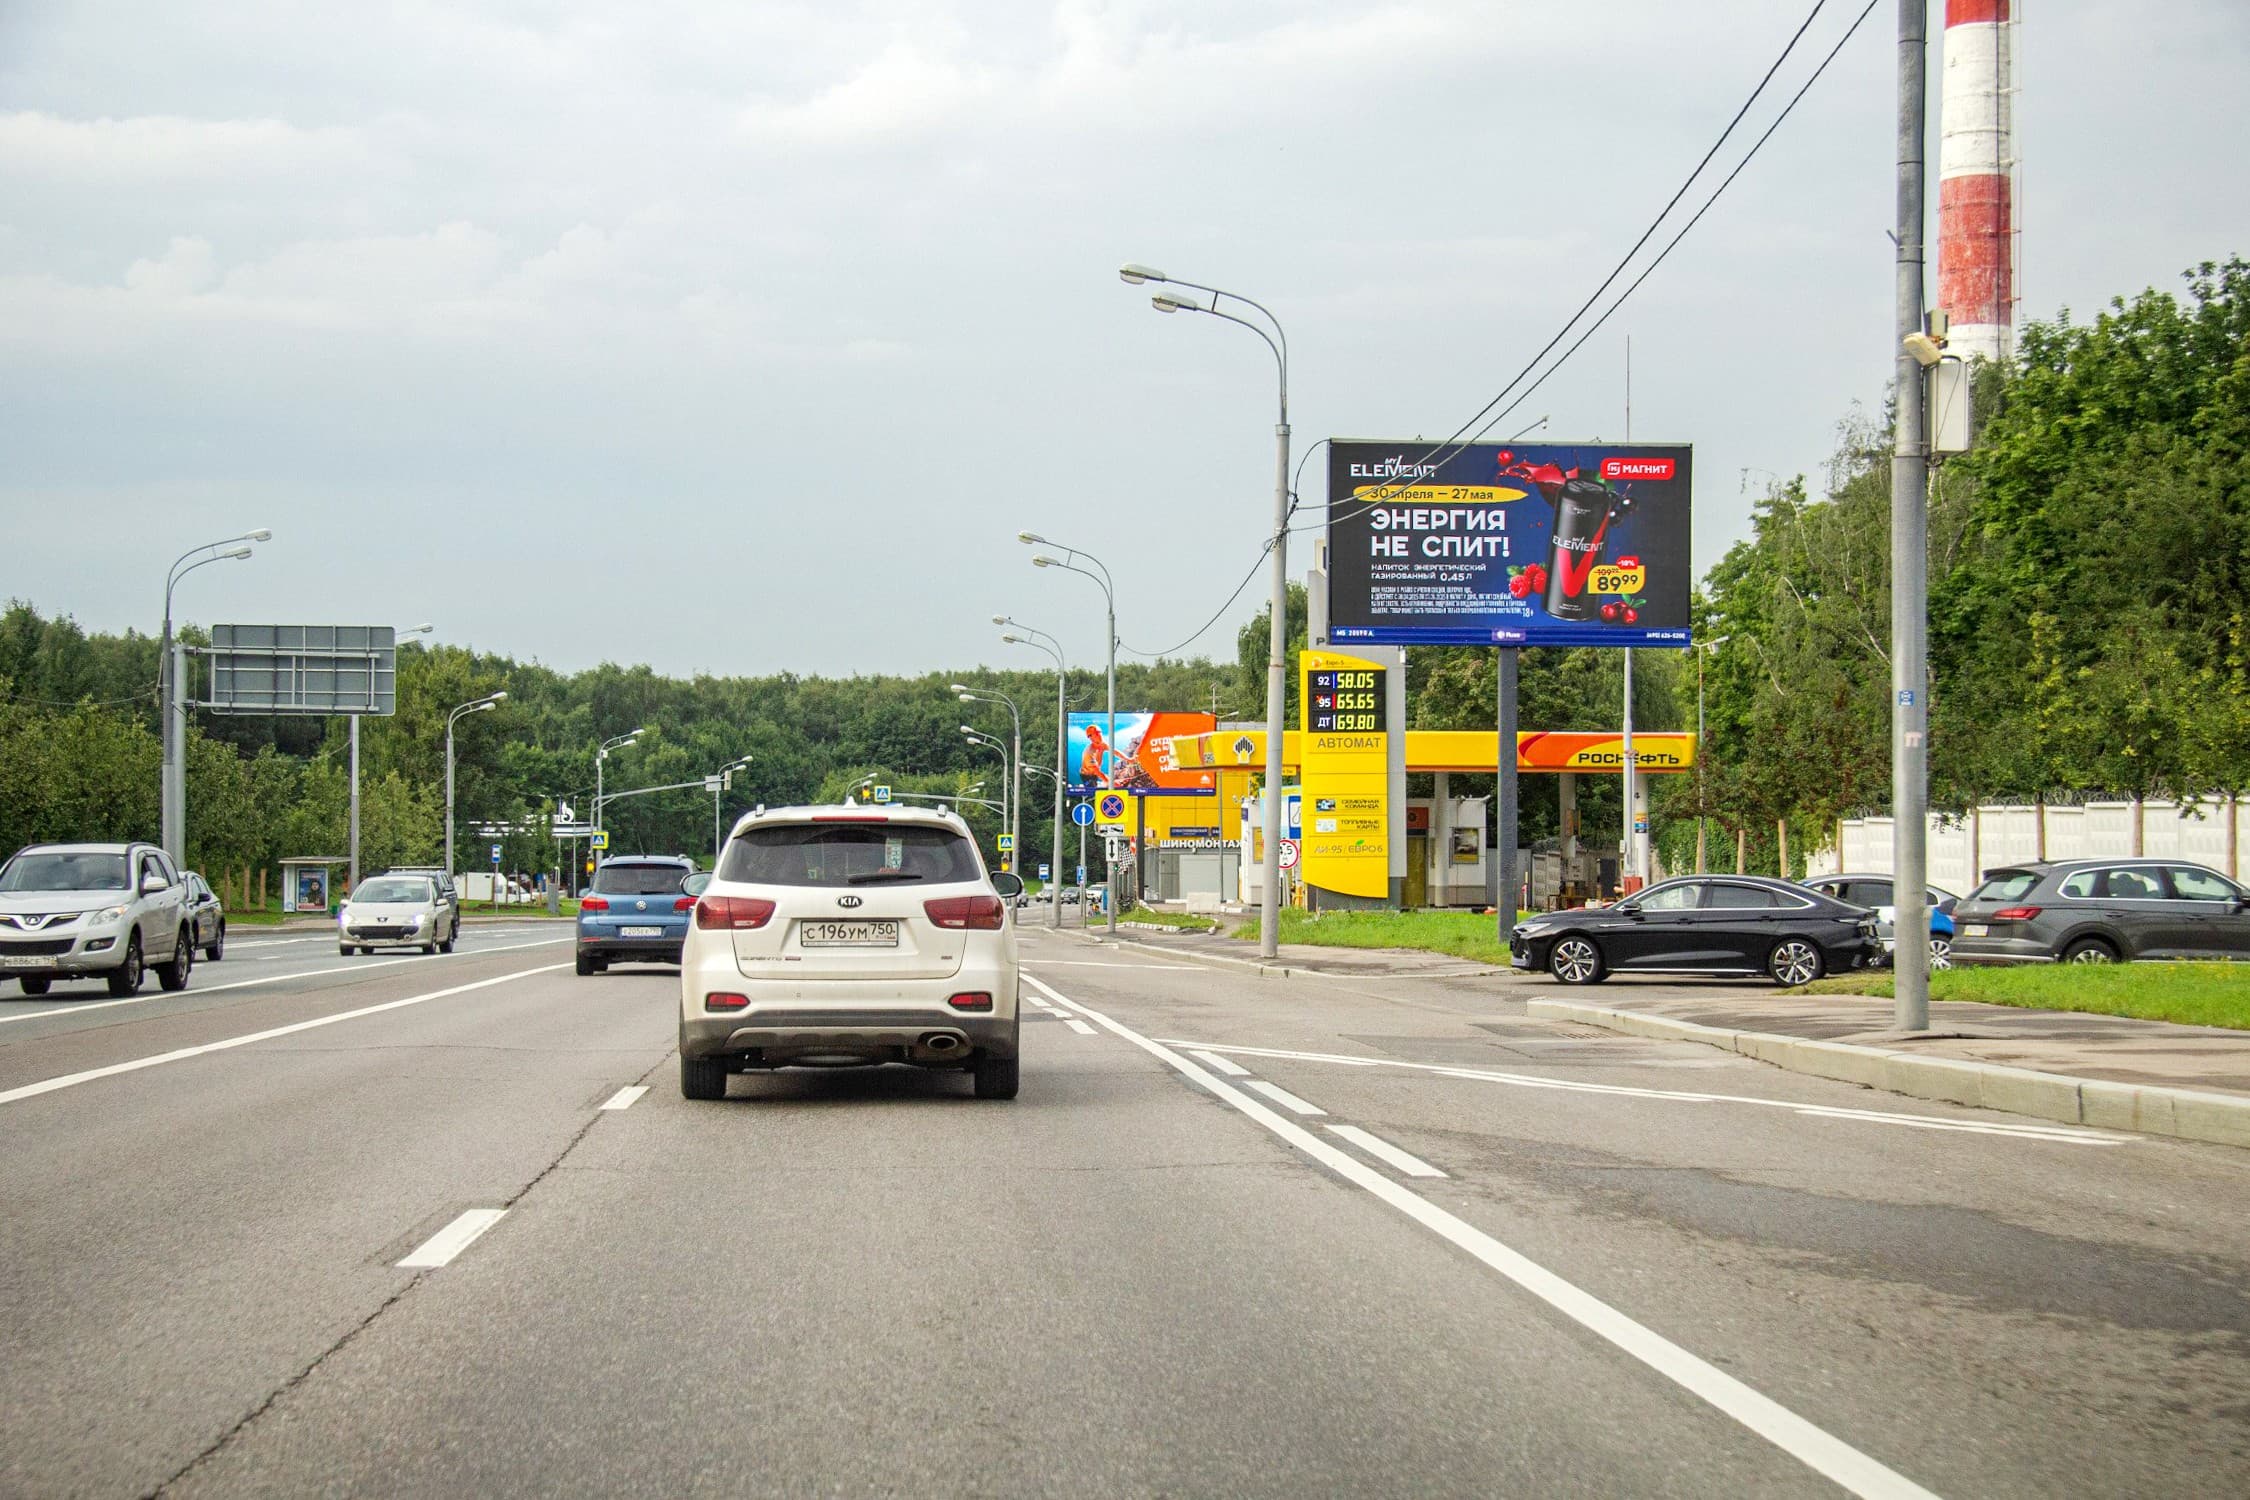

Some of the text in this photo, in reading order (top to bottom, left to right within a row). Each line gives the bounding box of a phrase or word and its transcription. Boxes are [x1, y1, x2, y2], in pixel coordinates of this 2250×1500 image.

[1622, 464, 1668, 475] МАГНИТ
[1451, 488, 1469, 499] 27
[1470, 491, 1494, 500] мая
[1370, 509, 1506, 531] ЭНЕРГИЯ
[1371, 535, 1511, 558] НЕ СПИТ!
[1371, 563, 1487, 572] НАПИТОК ЭНЕРГЕТИЧЕСКИЙ
[1371, 572, 1437, 580] ГАЗИРОВАННЫЙ
[1317, 673, 1375, 689] 92 58.05
[1318, 693, 1375, 709] 95 65.65
[1317, 714, 1376, 730] ДТ 69.80
[1317, 737, 1381, 748] АВТОМАТ
[1578, 752, 1680, 764] РОСНЕФТЬ
[1160, 839, 1242, 849] ШИНОМОНТАЖ
[840, 897, 860, 906] KIA
[871, 923, 893, 935] 750
